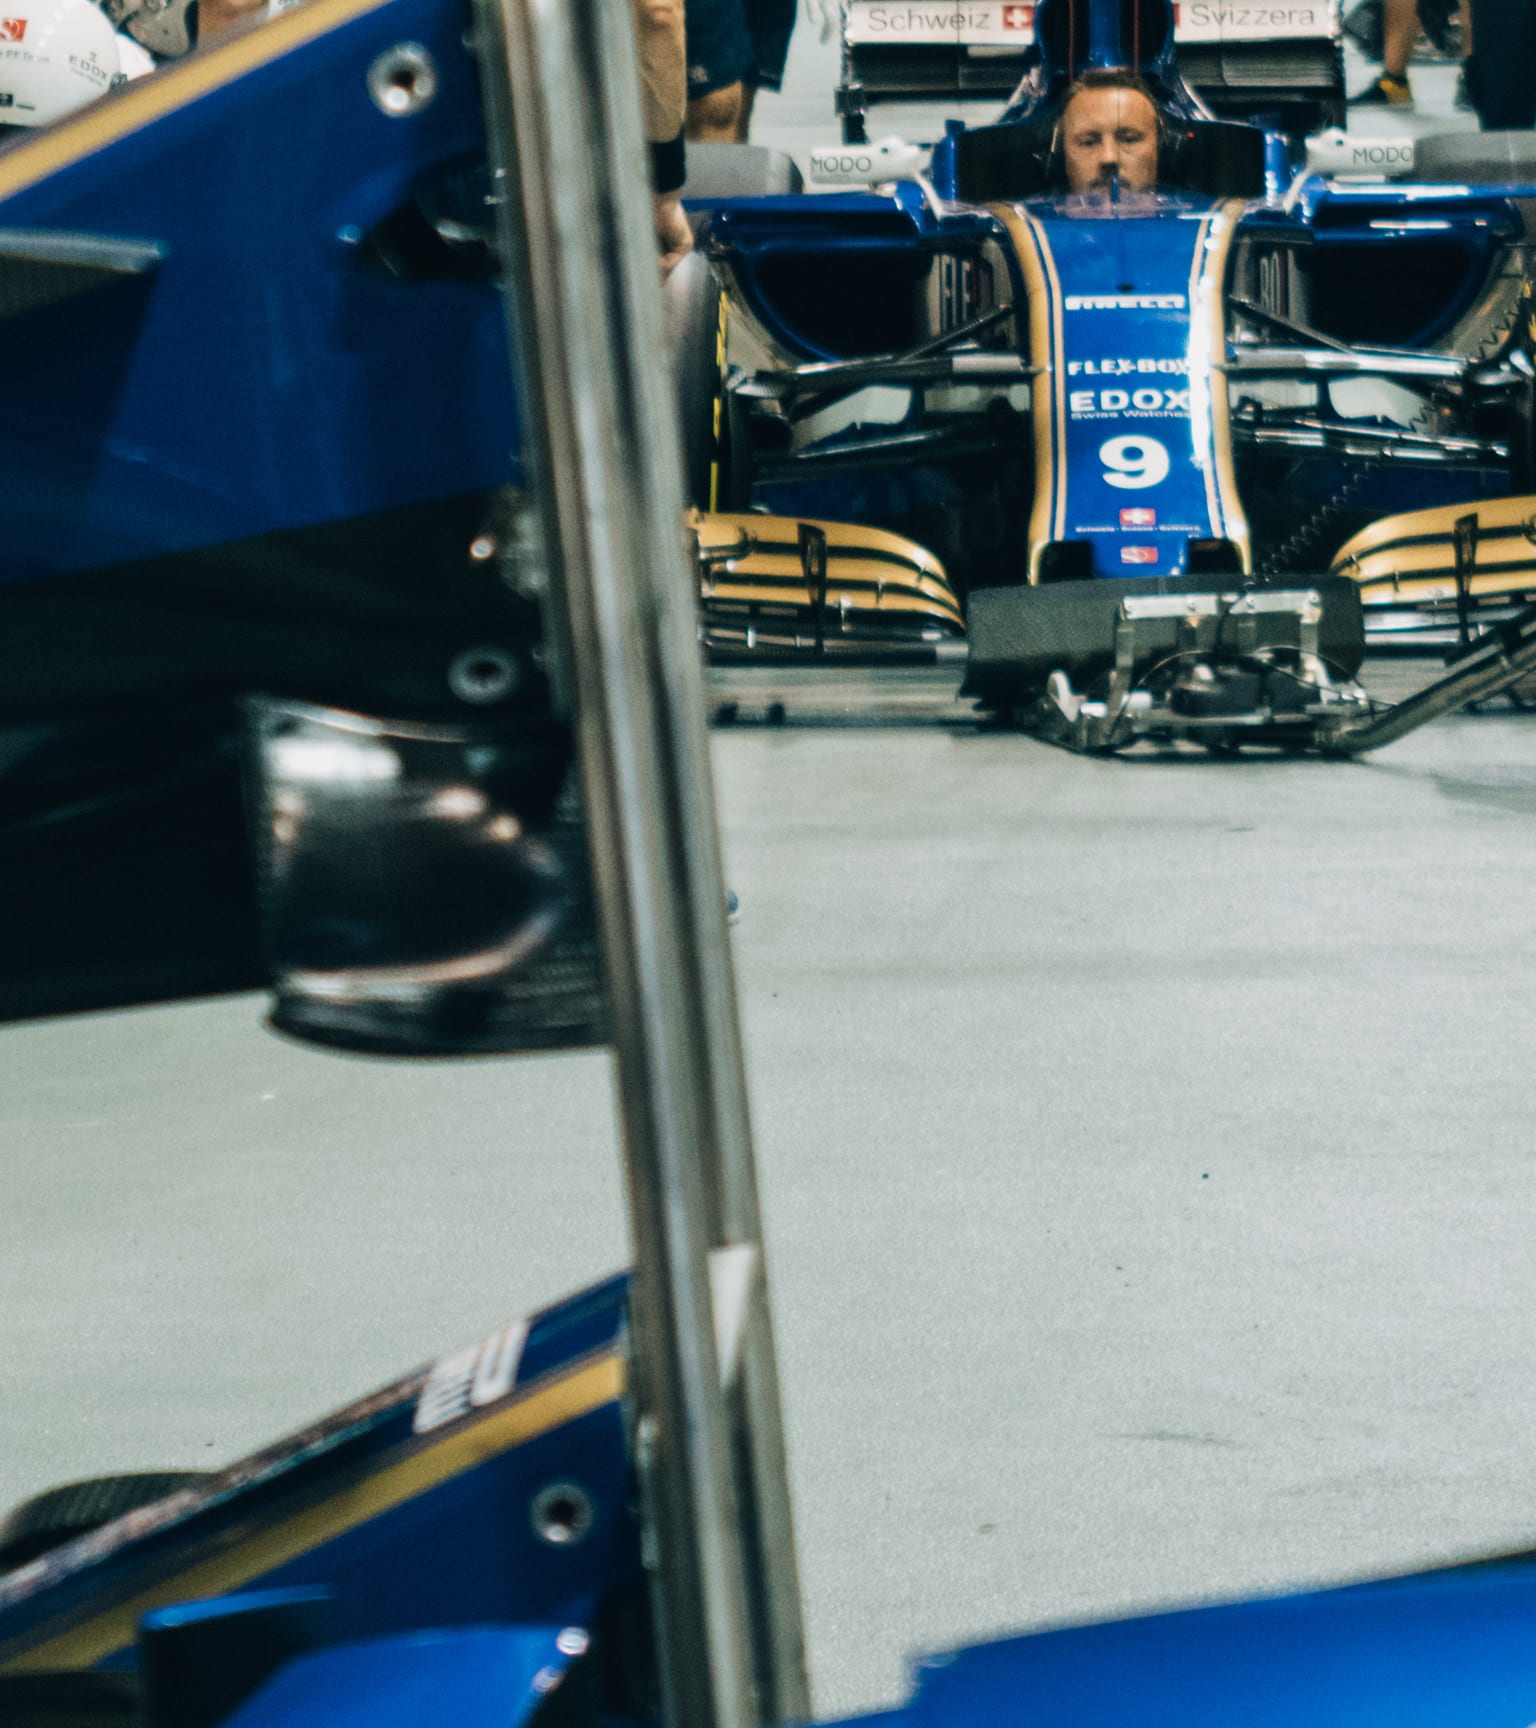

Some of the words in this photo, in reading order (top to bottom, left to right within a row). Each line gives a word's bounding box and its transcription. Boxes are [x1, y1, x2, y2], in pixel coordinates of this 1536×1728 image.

[867, 8, 992, 32] Schweiz
[1190, 3, 1316, 28] Svizzera
[68, 55, 108, 81] EDOX
[810, 155, 872, 173] MODO
[1068, 358, 1190, 376] FLEX-BOX
[1070, 388, 1191, 412] EDOX
[1071, 411, 1118, 420] Swiss
[1099, 434, 1170, 489] 9
